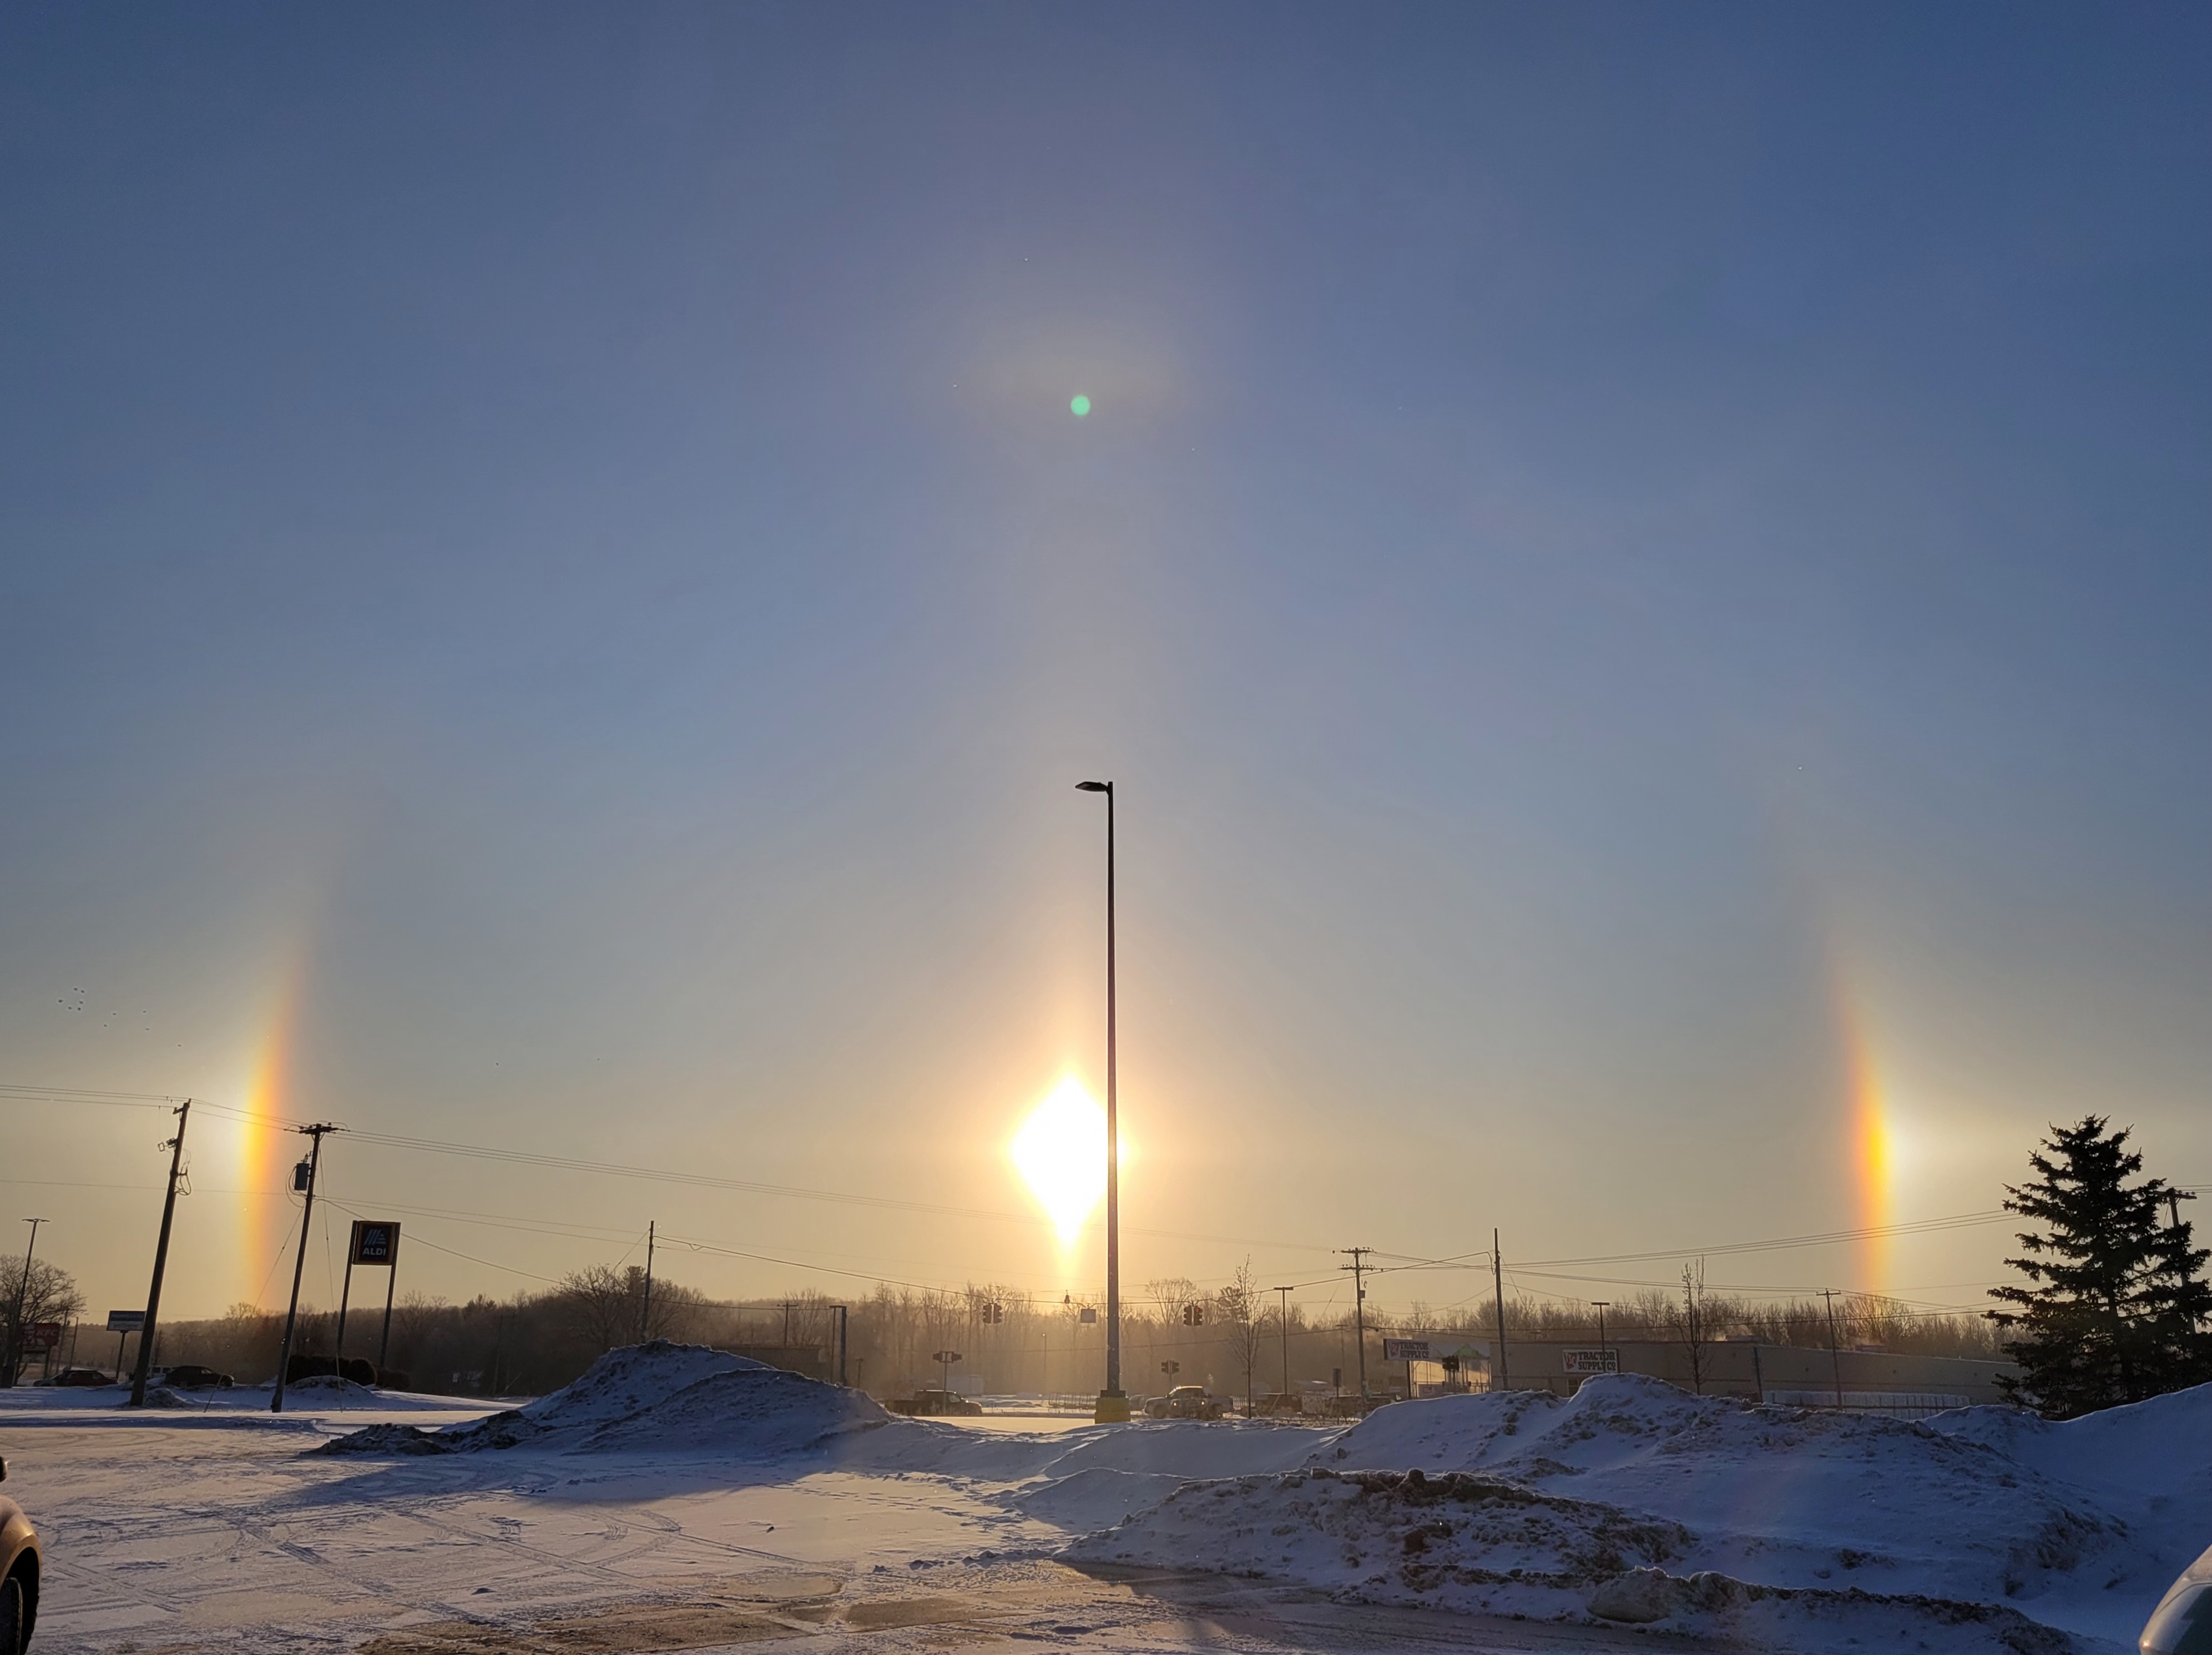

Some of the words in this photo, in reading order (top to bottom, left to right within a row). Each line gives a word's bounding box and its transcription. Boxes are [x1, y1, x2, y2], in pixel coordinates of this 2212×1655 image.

[362, 1248, 386, 1256] ALDI
[1400, 1341, 1428, 1350] TRACTOR
[1578, 1352, 1615, 1361] TRACTOR
